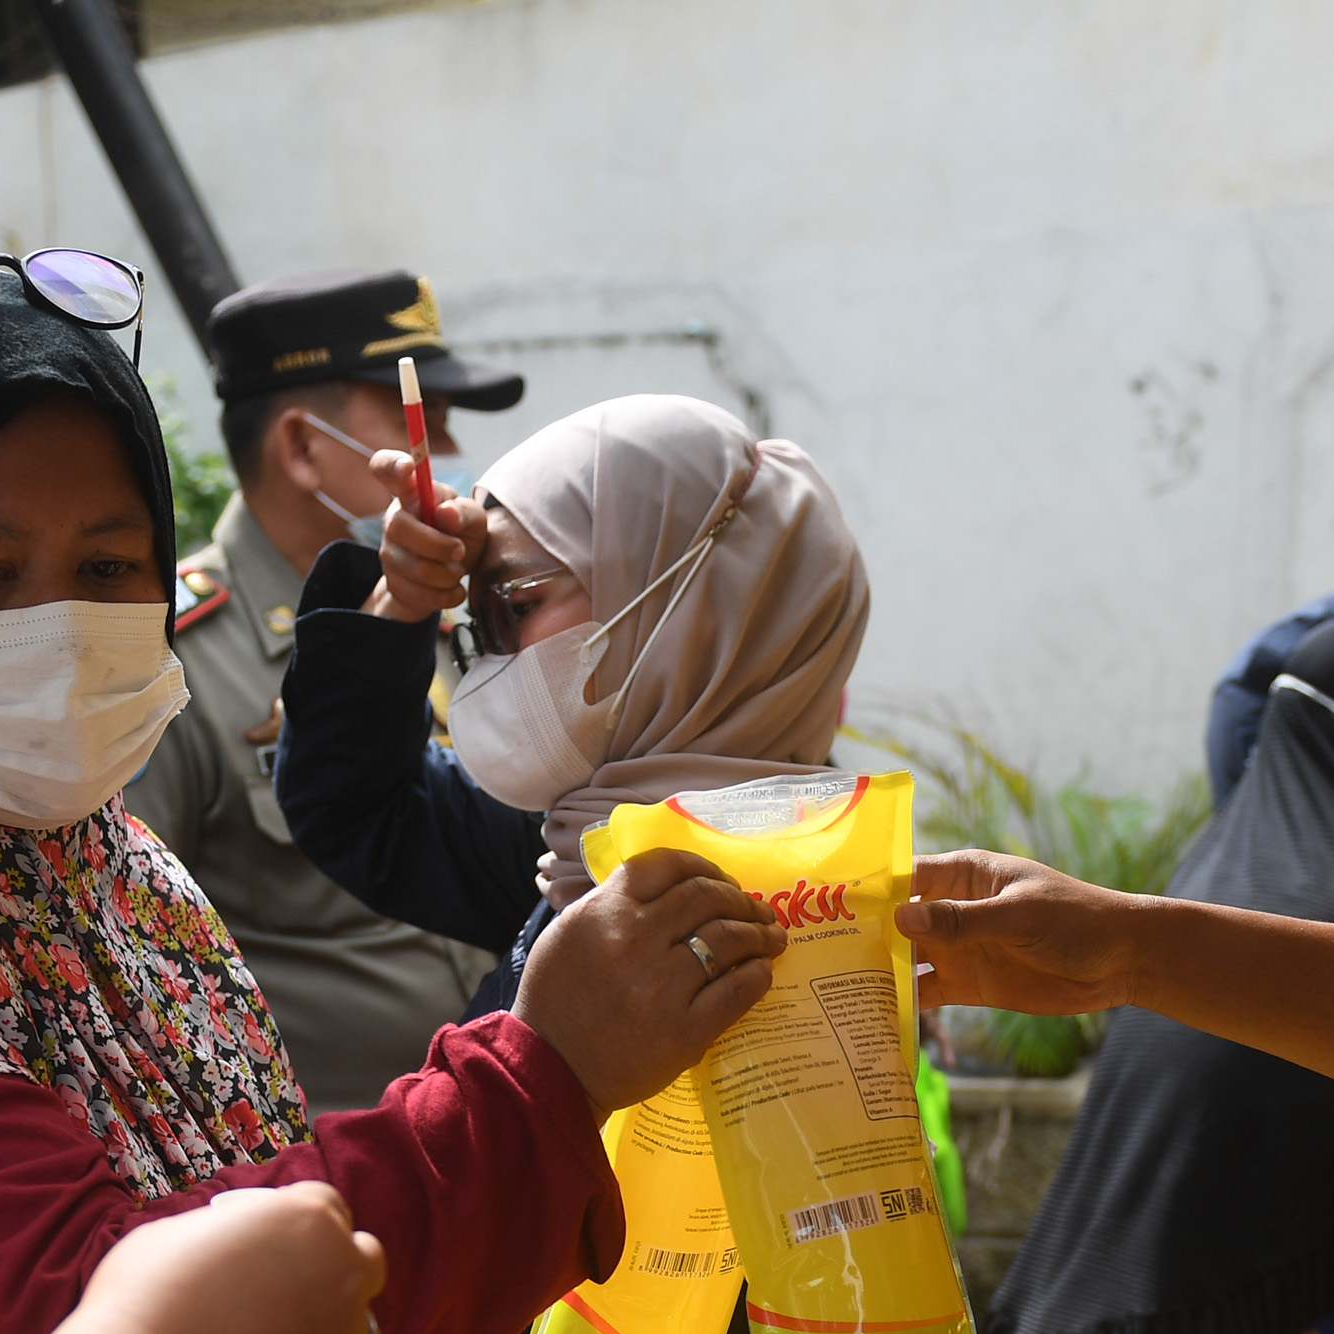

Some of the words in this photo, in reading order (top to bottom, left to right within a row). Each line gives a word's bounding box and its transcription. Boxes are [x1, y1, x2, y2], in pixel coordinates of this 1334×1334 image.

[743, 880, 855, 929] sku
[794, 934, 814, 944] PALM
[815, 928, 848, 939] COOKING
[818, 979, 850, 991] INFORMASI
[851, 977, 865, 987] NILAI
[844, 1000, 858, 1008] Total
[855, 1065, 873, 1073] Protein
[869, 1107, 886, 1115] Vitamin
[882, 1194, 906, 1214] SNI
